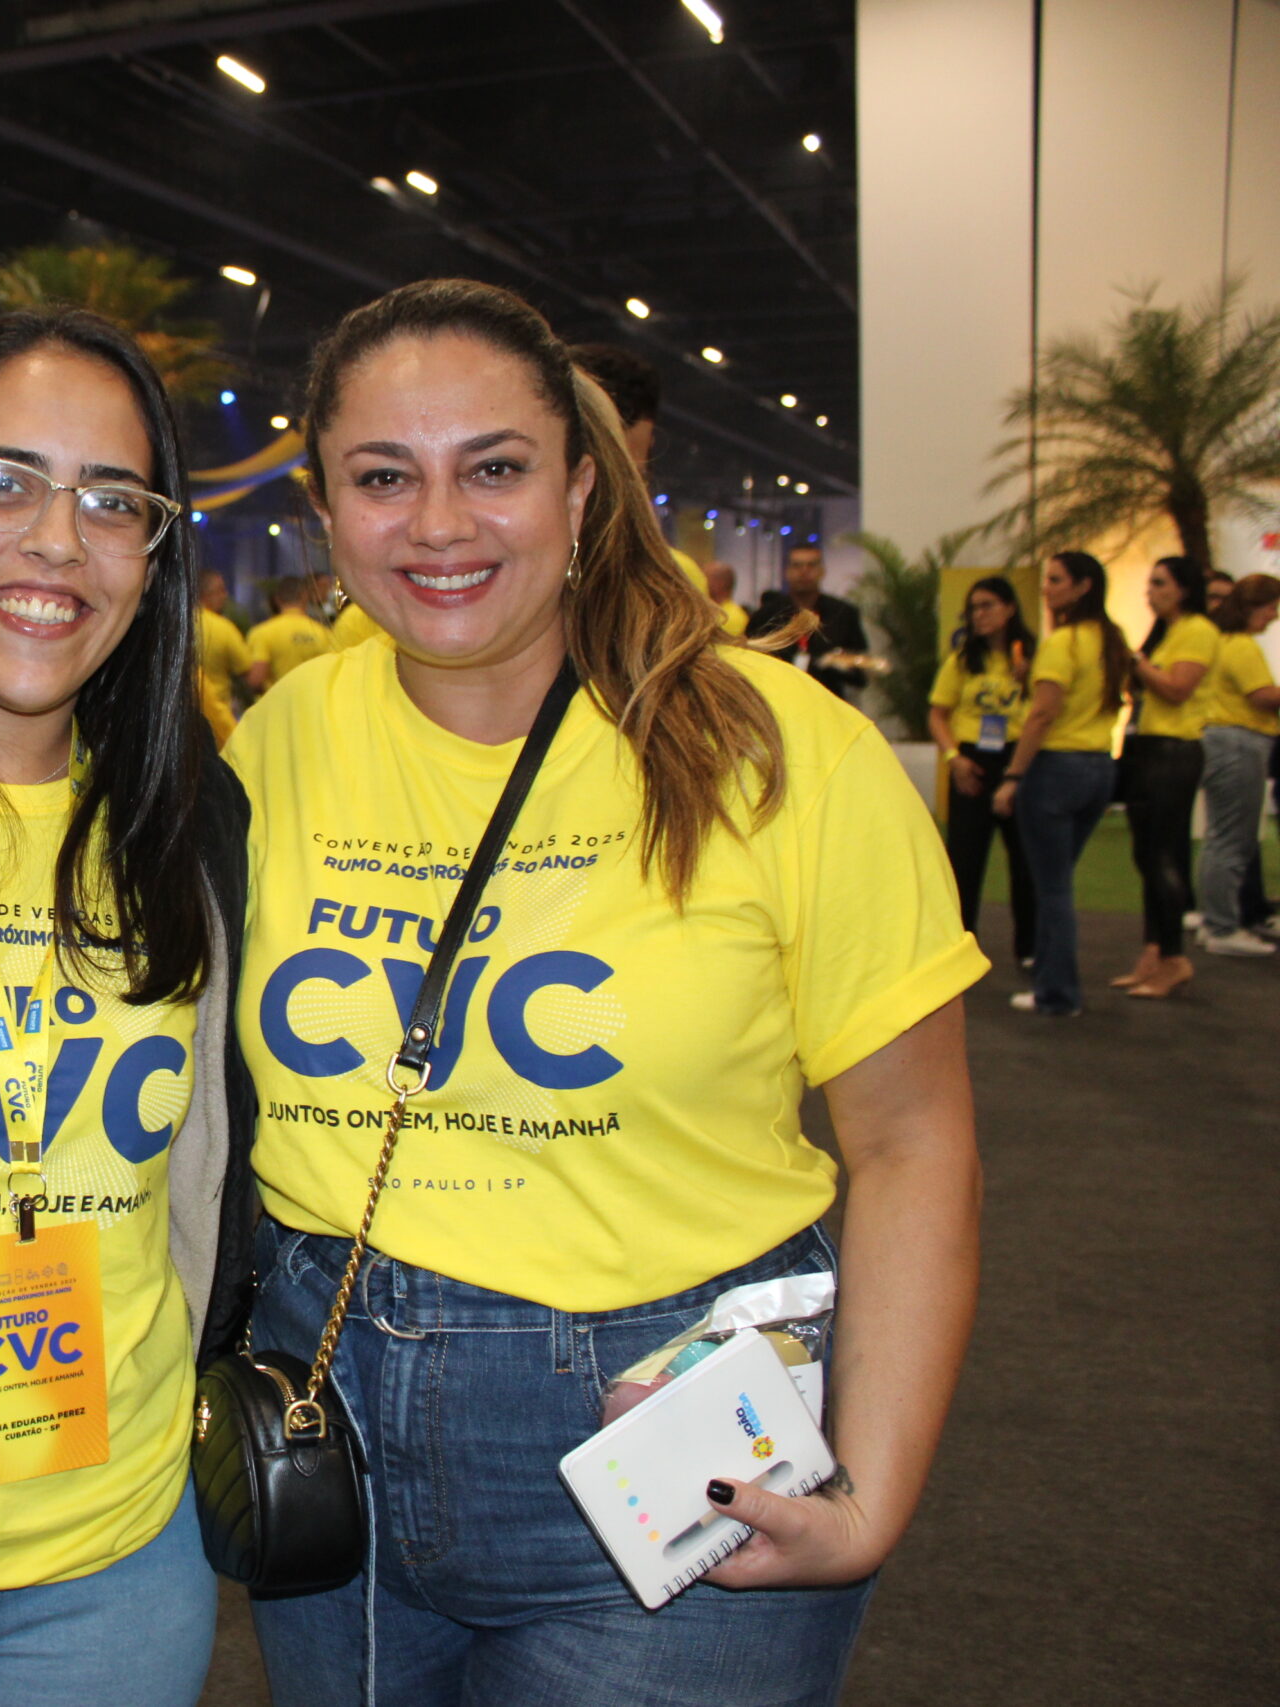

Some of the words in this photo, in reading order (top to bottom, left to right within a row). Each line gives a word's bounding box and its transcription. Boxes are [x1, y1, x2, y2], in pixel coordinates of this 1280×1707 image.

[313, 833, 433, 858] CONVENÇÃO
[447, 846, 471, 860] DE
[505, 834, 556, 855] NDAS
[570, 831, 625, 848] 2025
[323, 855, 382, 873] RUMO
[385, 863, 429, 881] AOS
[512, 861, 536, 874] 50
[539, 853, 598, 871] ANOS
[32, 907, 114, 927] VEDAS
[307, 897, 502, 954] FUTUO
[259, 947, 624, 1091] CVC
[4, 1077, 26, 1123] CVC
[267, 1101, 340, 1128] JUNTOS
[346, 1109, 440, 1134] ONTEM,
[445, 1113, 498, 1133] HOJE
[502, 1116, 514, 1134] E
[519, 1112, 621, 1139] AMANHÃ
[413, 1178, 476, 1191] PAULO
[503, 1178, 526, 1190] SP
[80, 1195, 94, 1212] E
[13, 1291, 45, 1302] PRÓXIMOS
[55, 1286, 72, 1294] ANOS
[31, 1281, 58, 1291] VENDAS
[3, 1382, 29, 1392] ONTEM,
[30, 1377, 48, 1387] HOJE
[54, 1369, 85, 1382] AMANHÃ
[11, 1414, 56, 1430] EDUARDA
[57, 1407, 86, 1420] PEREZ
[736, 1407, 757, 1440] JOÃO
[5, 1427, 42, 1441] CUBATÃO
[50, 1423, 61, 1432] SP
